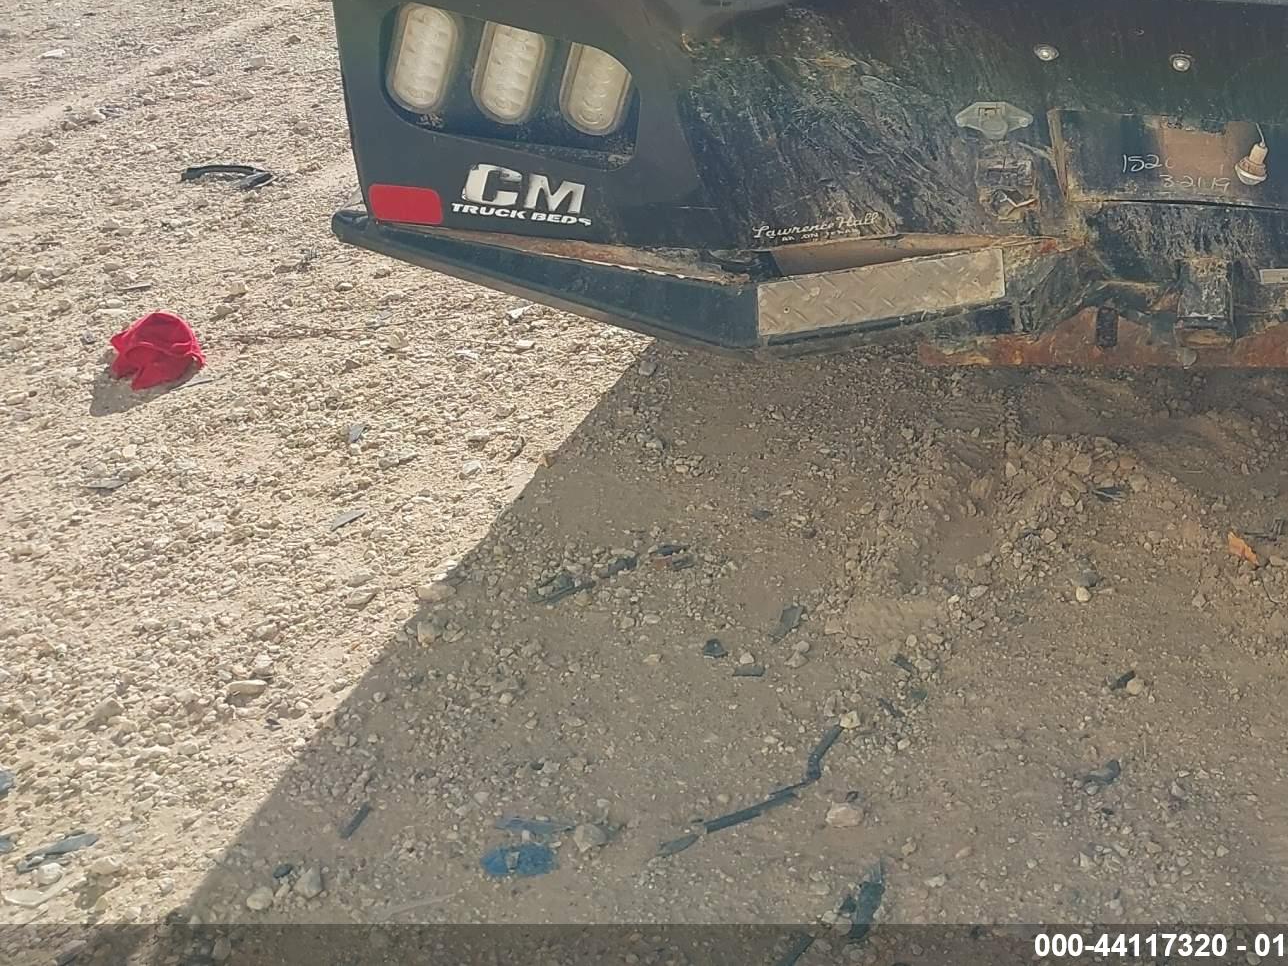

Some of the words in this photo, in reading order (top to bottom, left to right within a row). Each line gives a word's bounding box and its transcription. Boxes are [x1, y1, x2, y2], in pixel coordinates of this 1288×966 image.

[461, 163, 586, 214] CM
[450, 202, 528, 220] TRUCK
[530, 212, 593, 227] BEDS
[752, 220, 835, 239] Lawrence
[836, 211, 879, 229] Hall
